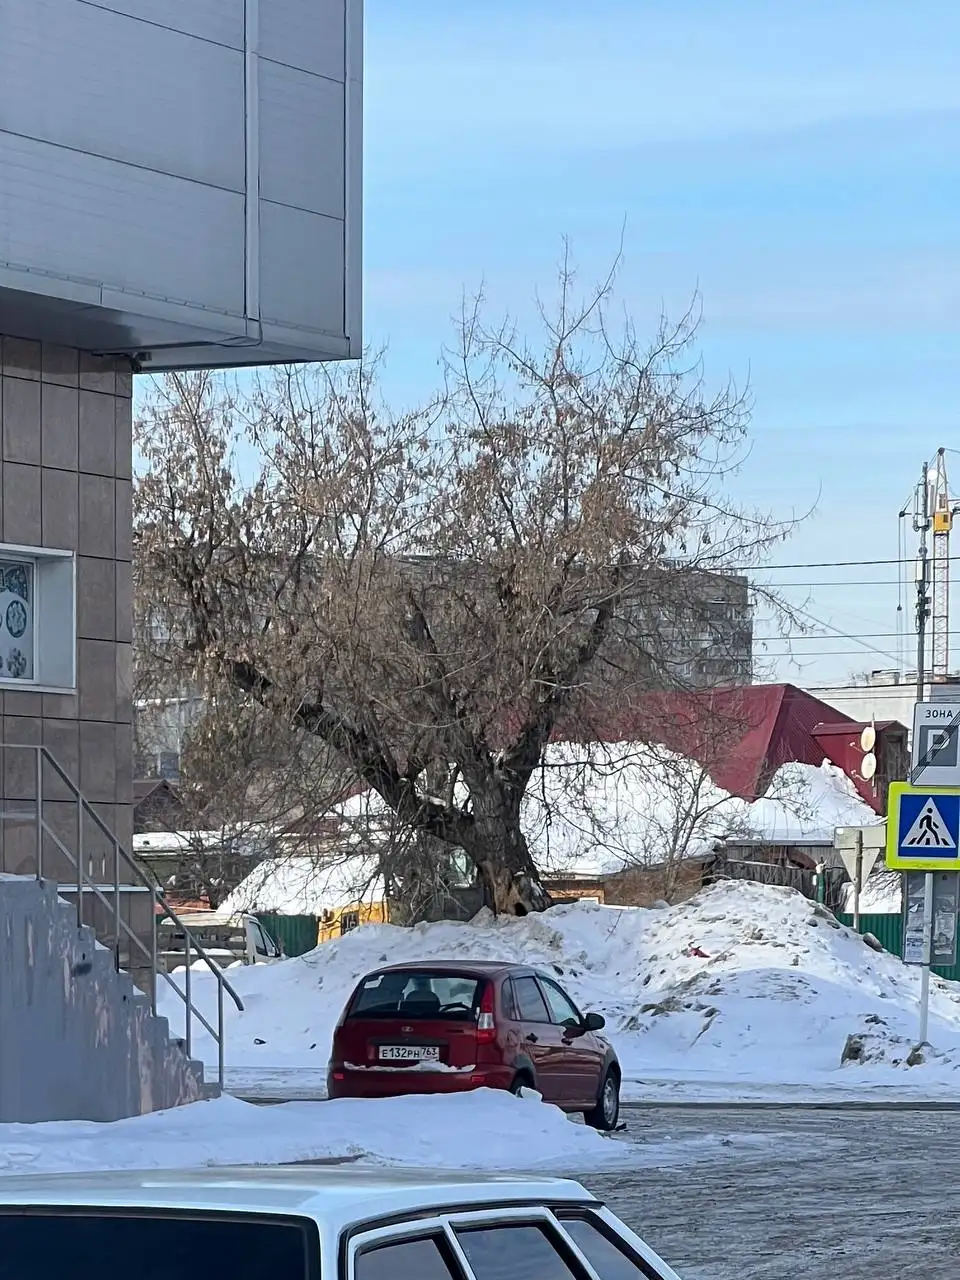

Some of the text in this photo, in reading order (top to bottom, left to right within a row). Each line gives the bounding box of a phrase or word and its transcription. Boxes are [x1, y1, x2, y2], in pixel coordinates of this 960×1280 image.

[925, 709, 953, 719] ЗОНА
[382, 1047, 437, 1058] Е132РН 763
